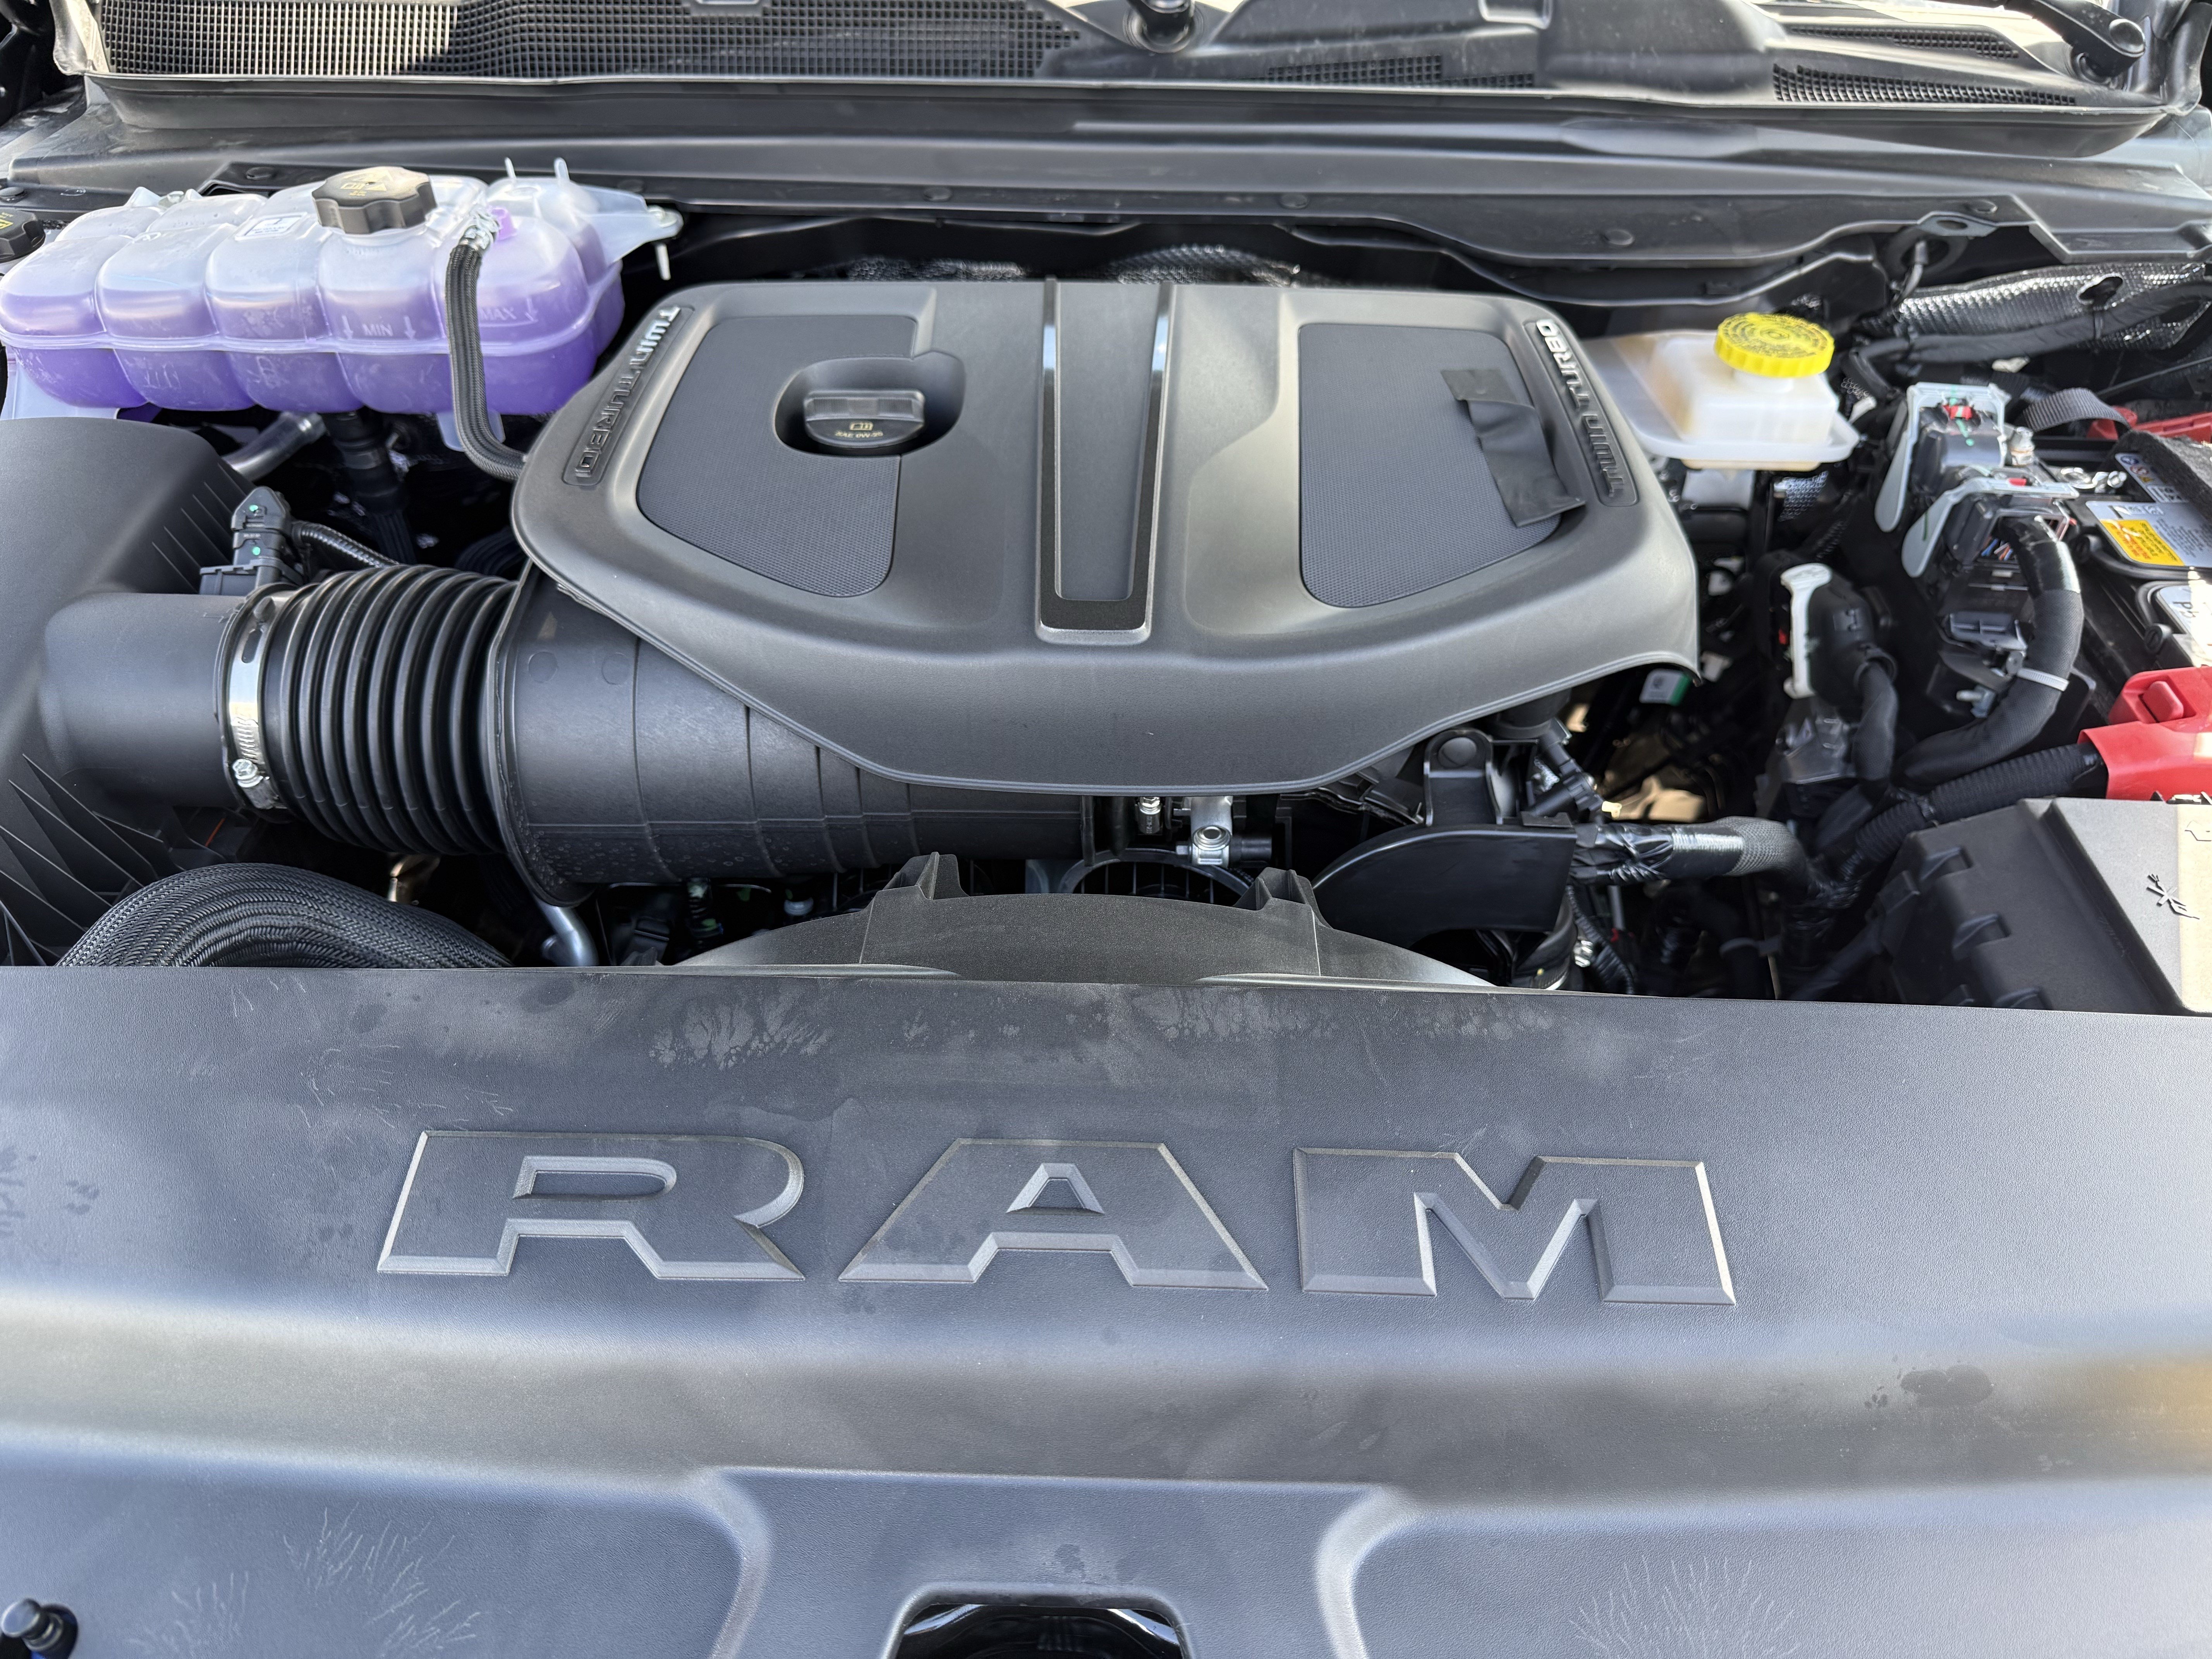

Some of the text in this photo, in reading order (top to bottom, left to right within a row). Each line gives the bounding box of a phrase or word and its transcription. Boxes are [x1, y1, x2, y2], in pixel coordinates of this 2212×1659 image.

[362, 323, 393, 337] MIN
[480, 307, 516, 321] MAX
[574, 305, 681, 477] TWIN TURBO
[1536, 319, 1624, 497] TWIN TURBO
[376, 1128, 1736, 1305] RAM
